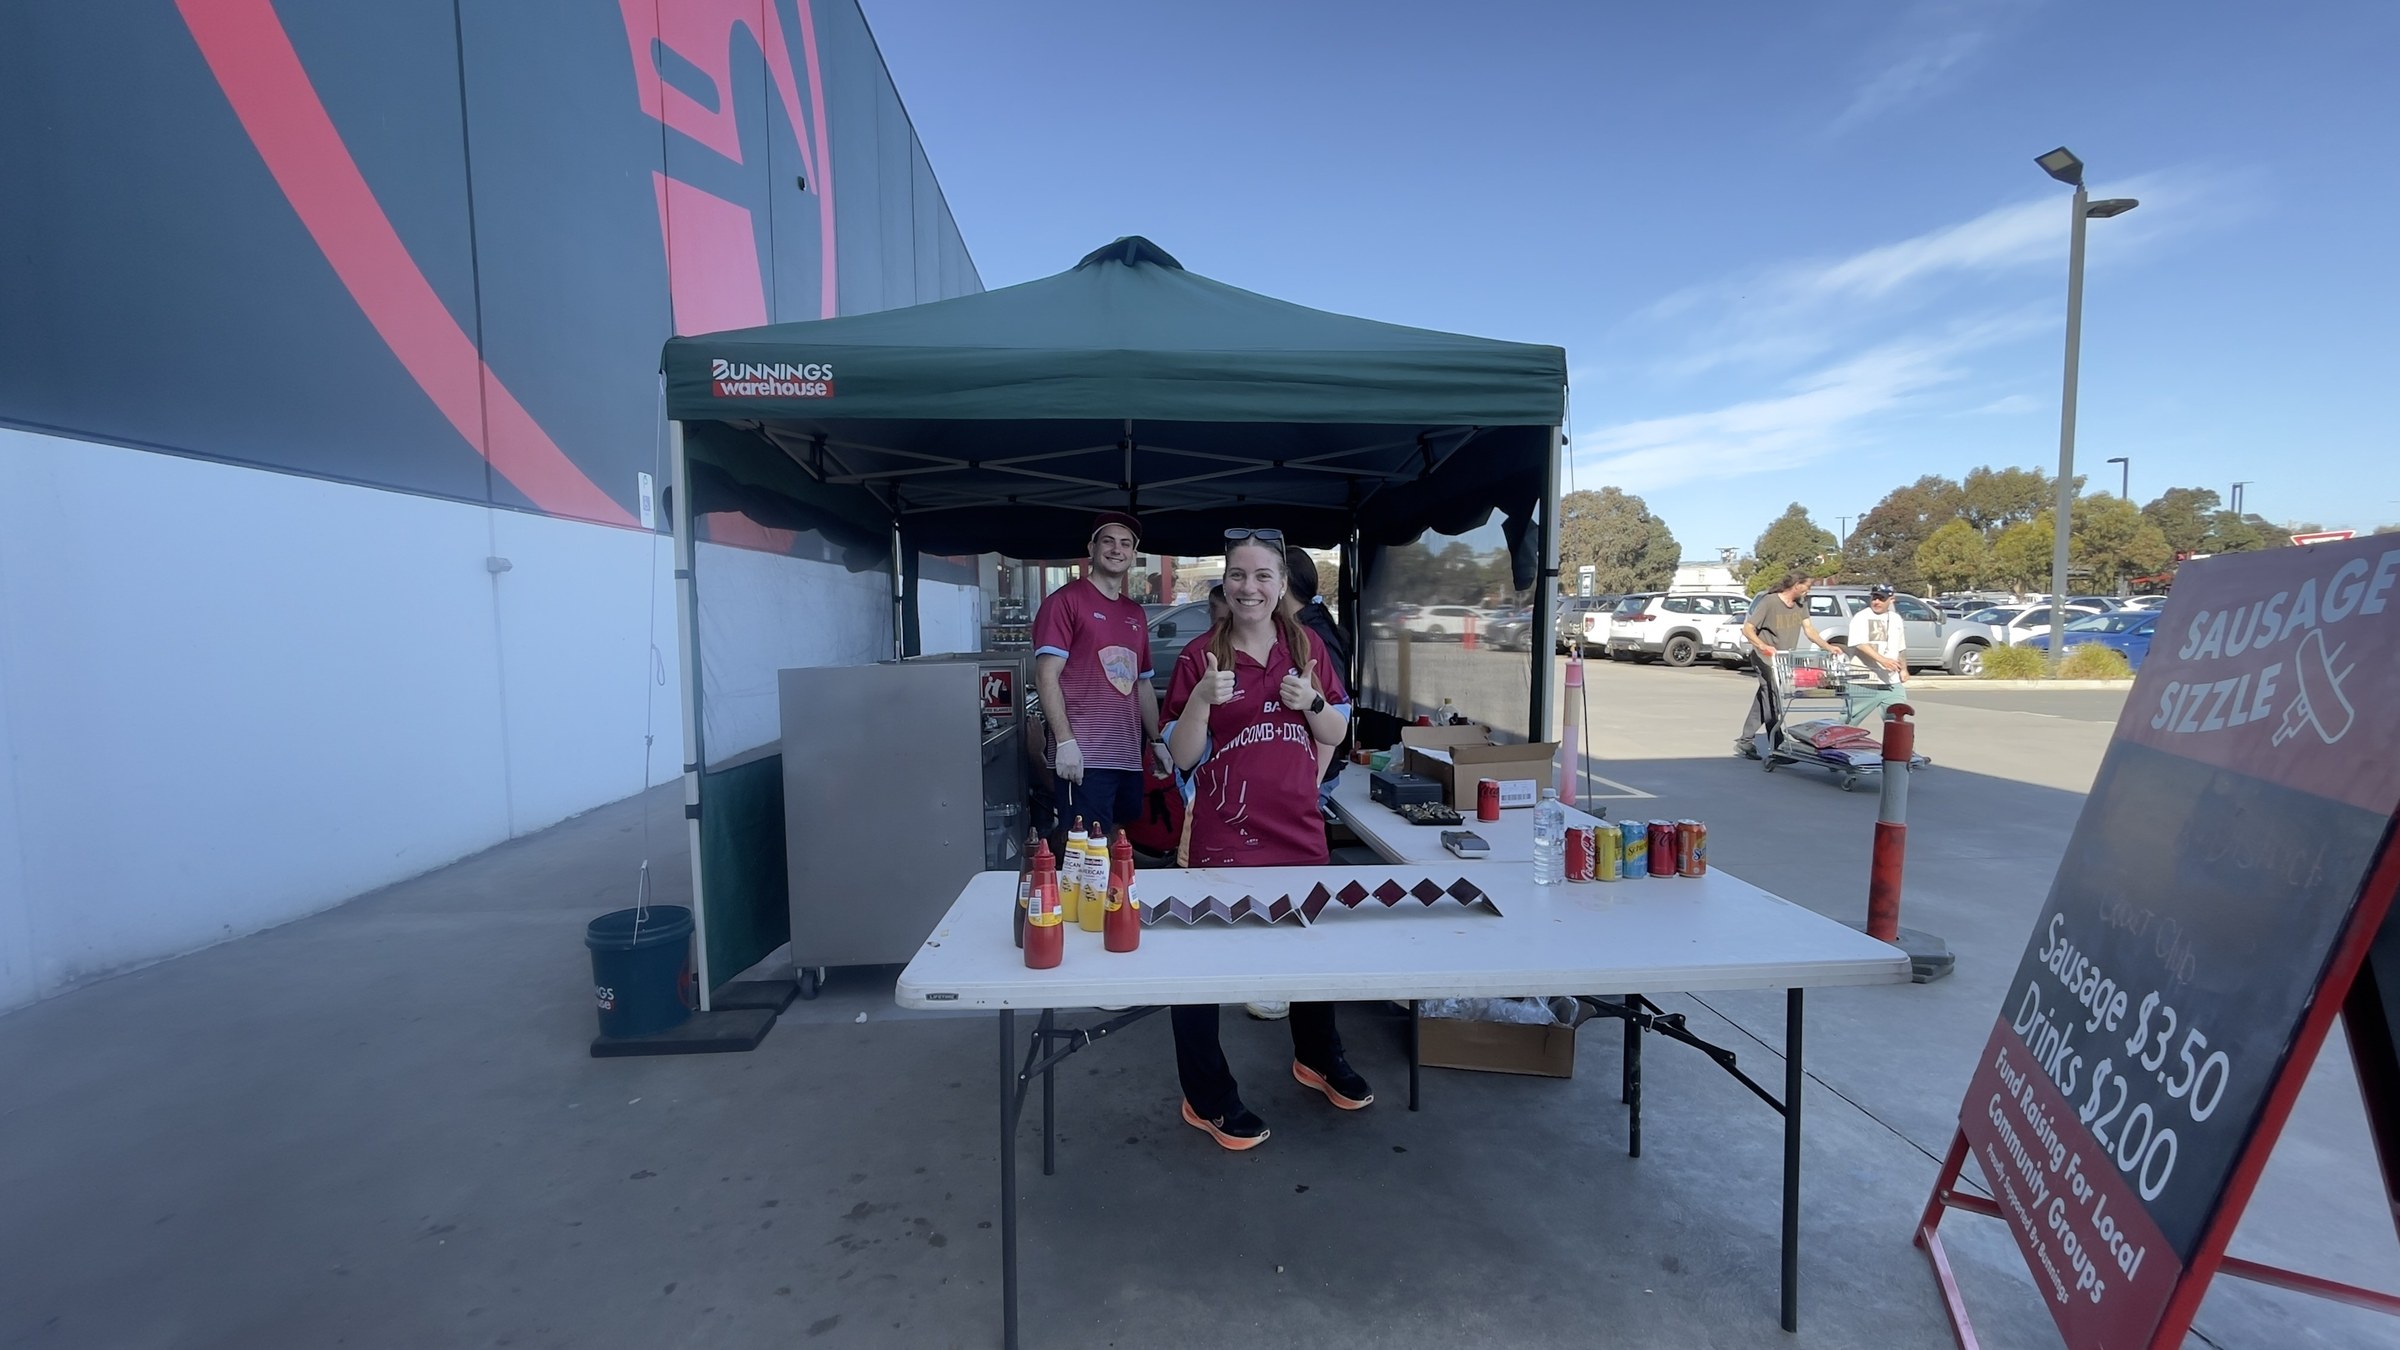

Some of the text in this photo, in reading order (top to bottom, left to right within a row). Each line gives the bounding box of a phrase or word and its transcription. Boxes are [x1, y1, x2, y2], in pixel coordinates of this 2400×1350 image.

[712, 358, 833, 381] BUNNINGS
[720, 376, 827, 396] warehouse
[2178, 549, 2400, 662] SAUSAGE
[2150, 662, 2283, 733] SIZZLE
[2013, 980, 2178, 1202] Drinks $2.00
[2039, 912, 2230, 1122] Sausage $3.50
[1986, 1142, 2069, 1305] Proudly Supported By Bunnings
[1988, 1093, 2105, 1304] Community Groups
[1994, 1046, 2146, 1282] Fund Raising For Local
